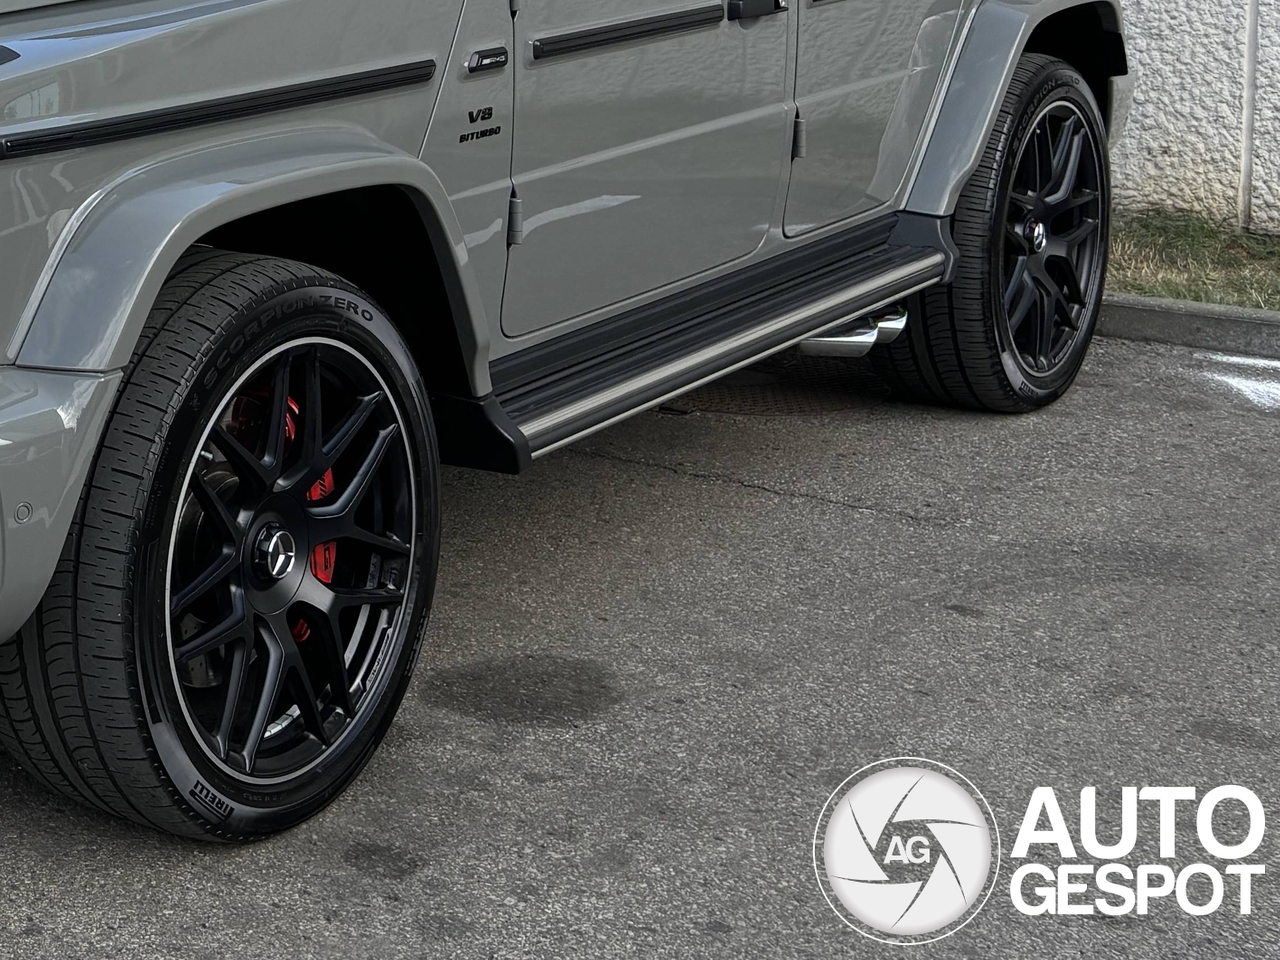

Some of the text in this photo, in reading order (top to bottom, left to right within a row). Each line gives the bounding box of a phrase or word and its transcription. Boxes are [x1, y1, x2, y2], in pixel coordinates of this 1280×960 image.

[468, 106, 493, 123] V8
[459, 126, 501, 143] BITURBO
[203, 295, 374, 390] SCORPION ZERO
[189, 780, 235, 820] PIRELLI
